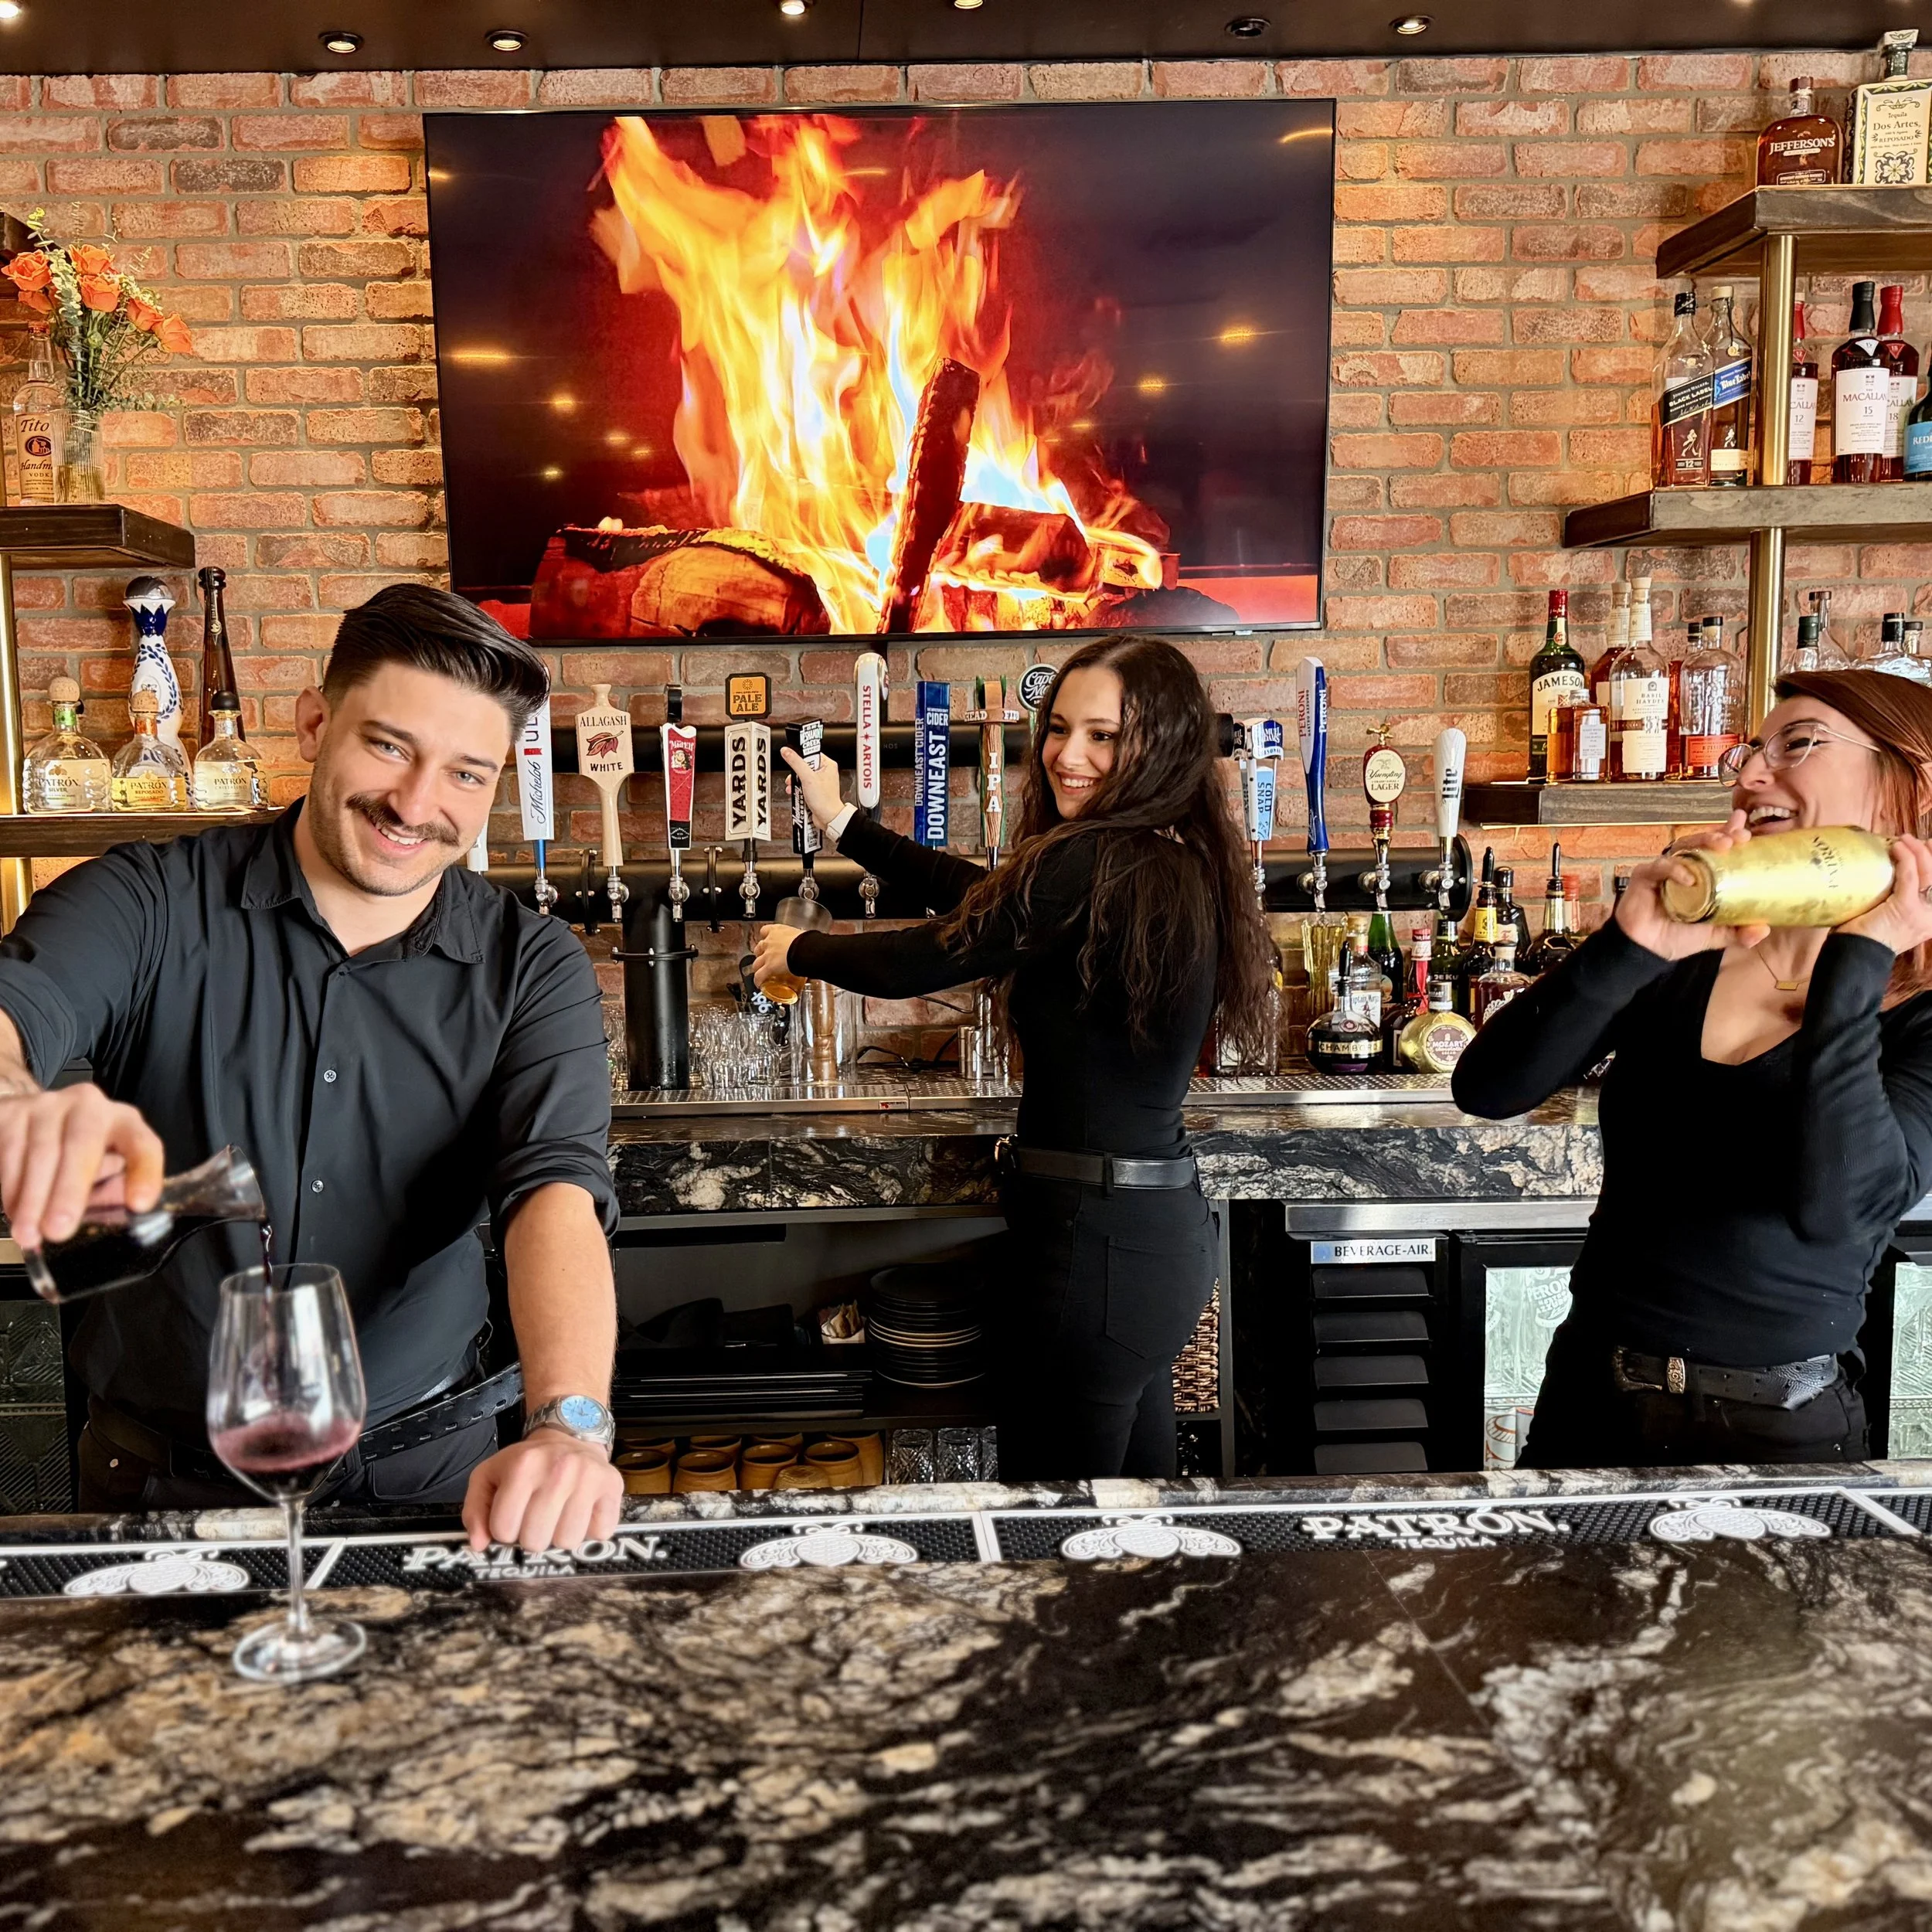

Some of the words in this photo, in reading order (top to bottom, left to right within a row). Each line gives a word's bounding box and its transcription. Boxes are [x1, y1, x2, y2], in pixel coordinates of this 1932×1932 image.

[1873, 122, 1891, 131] Dos
[1769, 134, 1836, 155] JEFFERSON'S
[1669, 395, 1691, 407] BLACK
[1691, 387, 1713, 398] LABEL
[1795, 414, 1804, 423] 12
[1864, 406, 1873, 415] 15
[21, 418, 49, 433] Tito
[20, 459, 53, 471] Handm
[1685, 460, 1695, 468] 12
[1026, 672, 1057, 689] Cape
[1537, 675, 1583, 692] JAMESON
[733, 694, 762, 703] PALE
[1024, 685, 1049, 701] Ma
[736, 703, 759, 712] ALE
[862, 685, 872, 730] STELLA
[1318, 689, 1327, 733] PERONI
[580, 715, 627, 727] ALLAGASH
[927, 712, 949, 726] CIDER
[915, 718, 924, 748] CIDER
[590, 761, 624, 772] WHITE
[862, 743, 872, 789] ARTOIS
[1367, 768, 1403, 780] Yuengling
[37, 777, 80, 787] PATRÓN
[131, 780, 168, 790] PATRÓN
[214, 775, 247, 785] PATRÓN
[732, 736, 747, 829] YARDS
[757, 737, 767, 828] YARDS
[915, 750, 924, 806] DOWNEAST
[927, 730, 947, 839] DOWNEAST
[986, 752, 1002, 813] IPA
[1441, 768, 1459, 801] Lite
[527, 760, 546, 824] Michelob
[1335, 1244, 1429, 1257] BEVERAGE-AIR
[1301, 1506, 1556, 1540] PATRÓN
[1391, 1536, 1498, 1550] TEQUILA
[474, 1564, 576, 1580] TEQUILA
